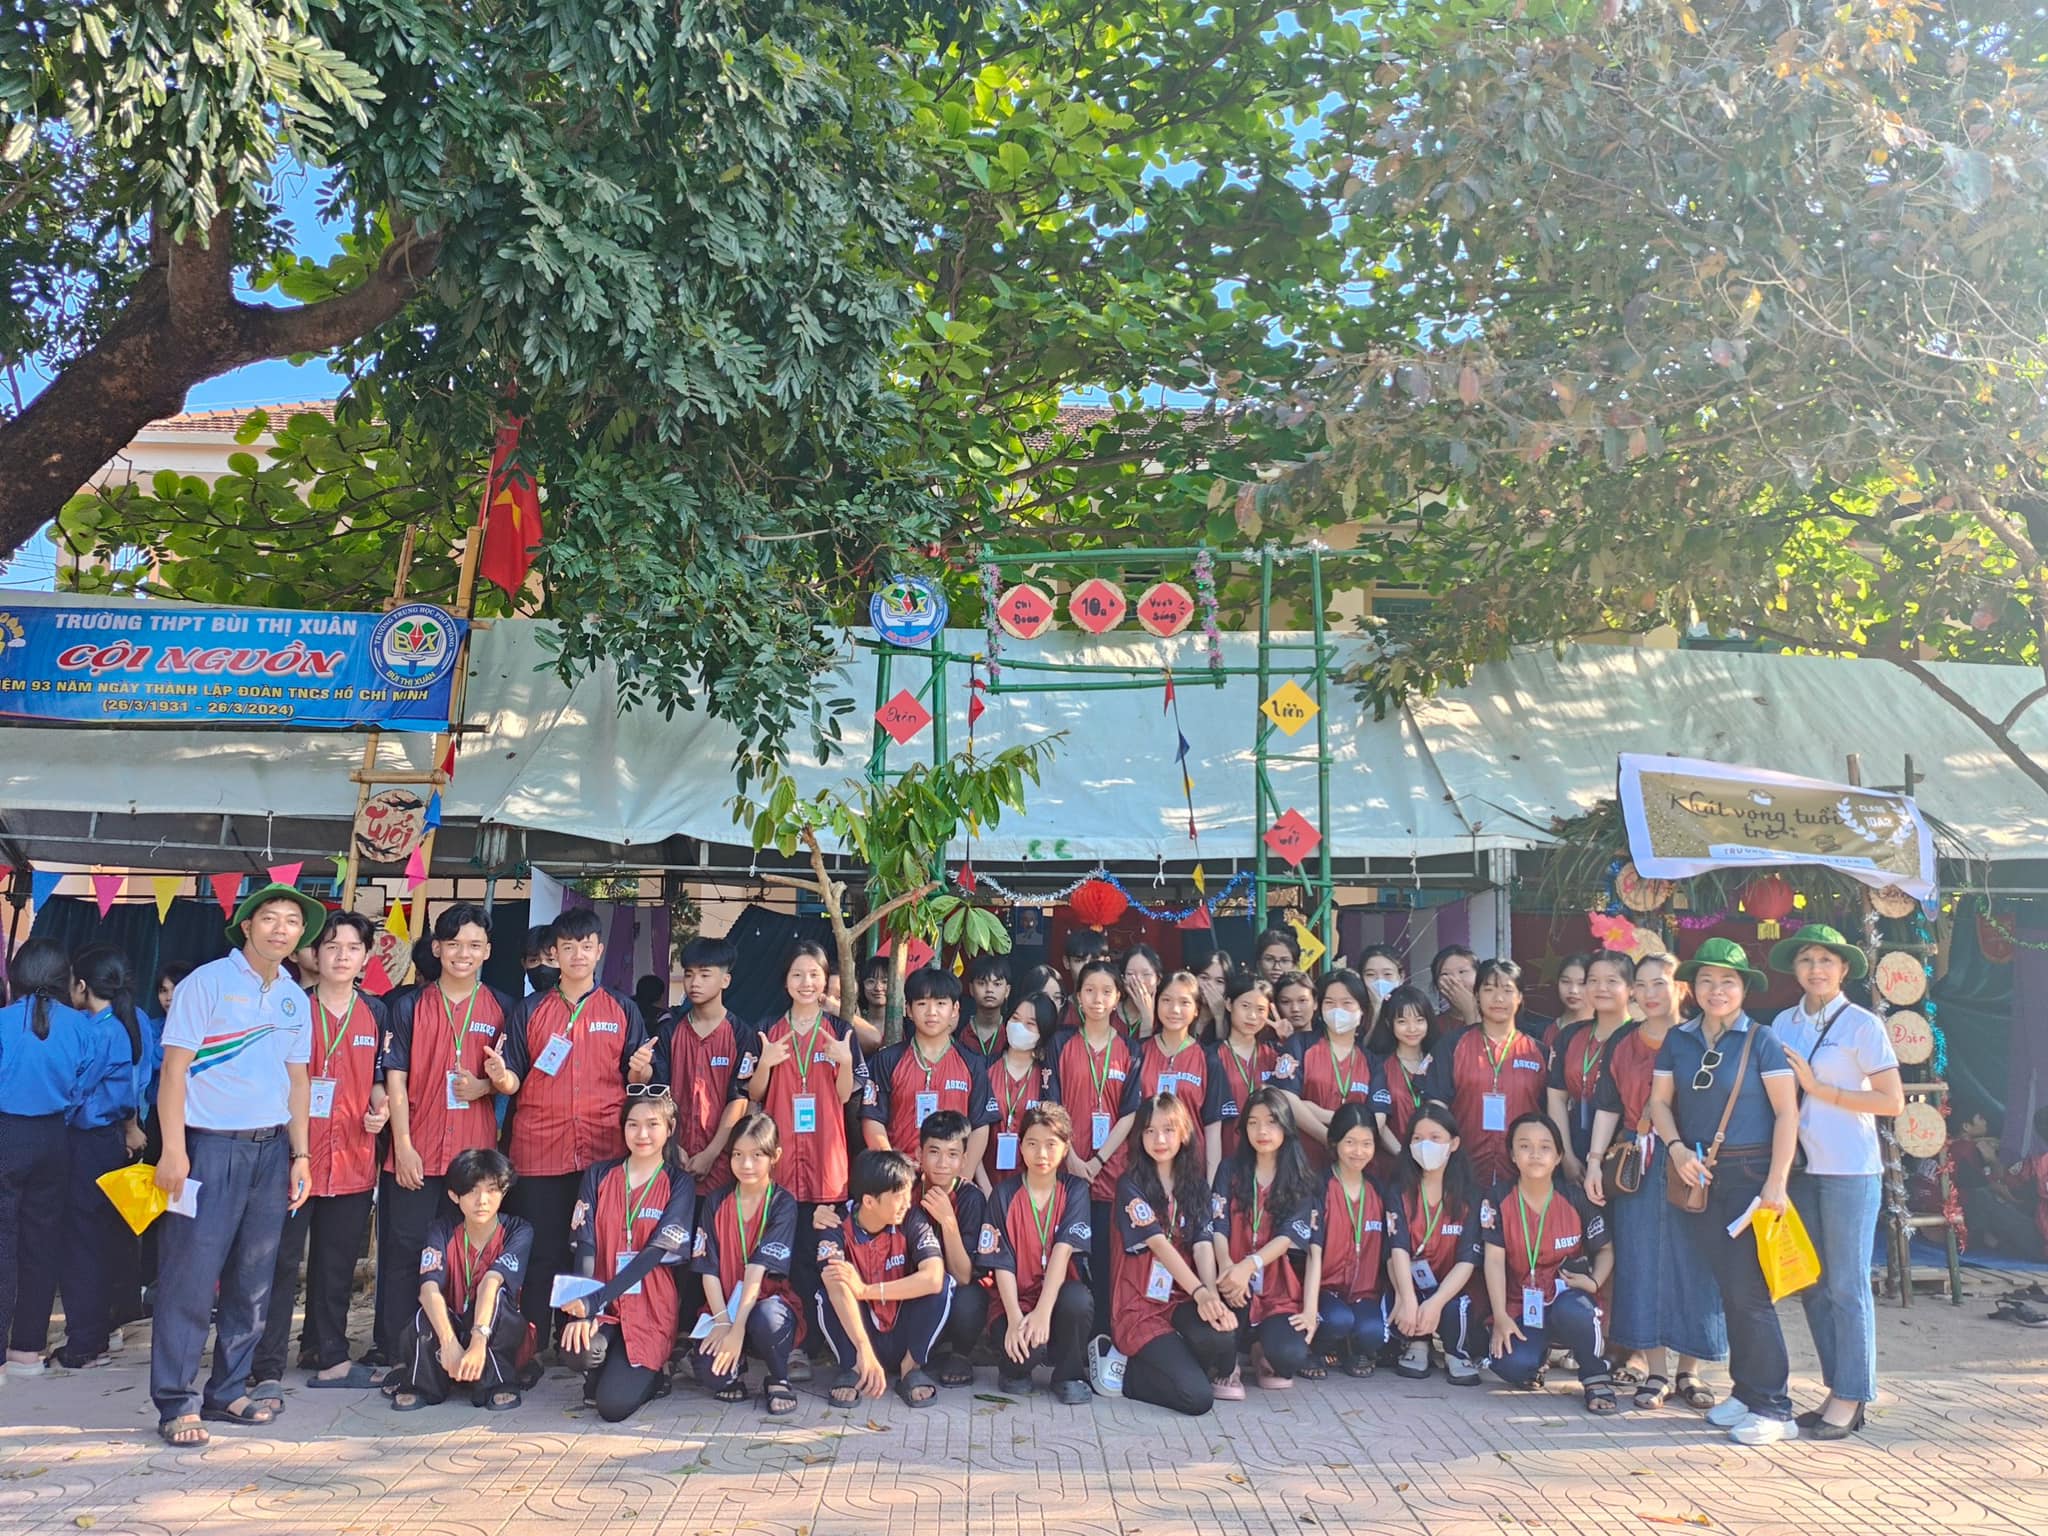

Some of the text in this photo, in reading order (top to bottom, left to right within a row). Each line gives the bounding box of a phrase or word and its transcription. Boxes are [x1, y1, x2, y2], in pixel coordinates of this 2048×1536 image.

[55, 612, 357, 637] TRƯỜNG THPT BÙI THỊ XUÂN
[58, 639, 346, 678] CỘI NGUỒN
[31, 681, 52, 692] 93
[56, 680, 92, 693] NĂM
[97, 681, 140, 695] NGÀY
[144, 681, 198, 696] THÀNH
[203, 684, 233, 698] LẬP
[237, 684, 283, 698] ĐOÀN
[288, 687, 330, 699] TNCS
[359, 687, 387, 701] CHÍ
[392, 690, 429, 701] MINH
[103, 700, 188, 712] (26/3/1931
[208, 701, 295, 716] 26/3/2024)
